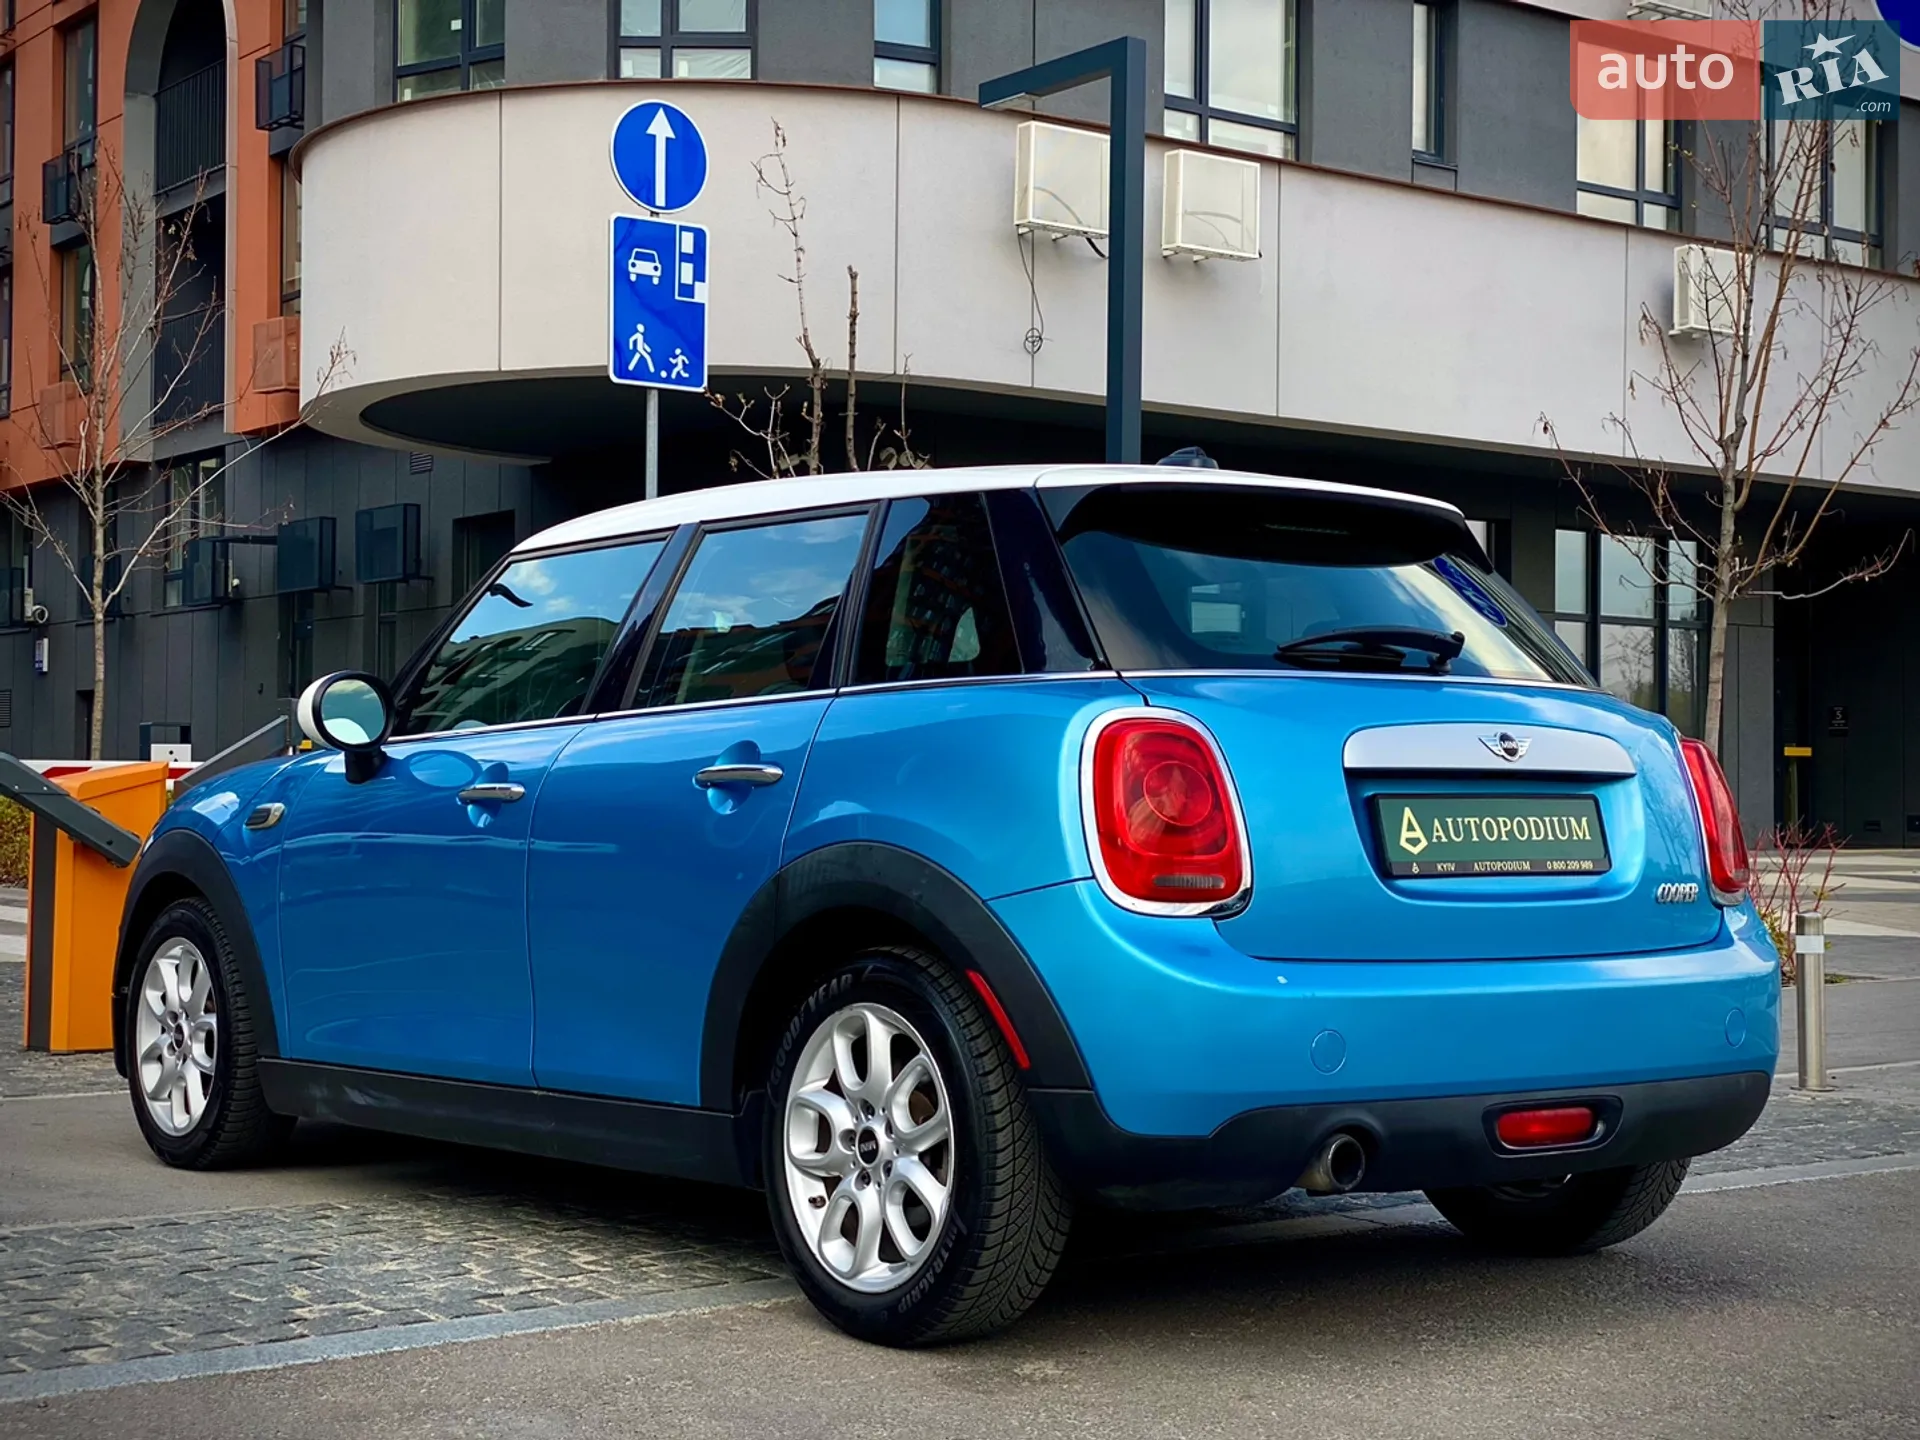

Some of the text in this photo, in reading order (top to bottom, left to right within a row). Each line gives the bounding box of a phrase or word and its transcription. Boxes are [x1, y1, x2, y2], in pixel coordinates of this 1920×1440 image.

[1432, 816, 1592, 843] AUTOPODIUM
[1436, 862, 1456, 871] KYIV
[1473, 861, 1531, 871] AUTOPODIUM
[1657, 882, 1699, 903] COOPER
